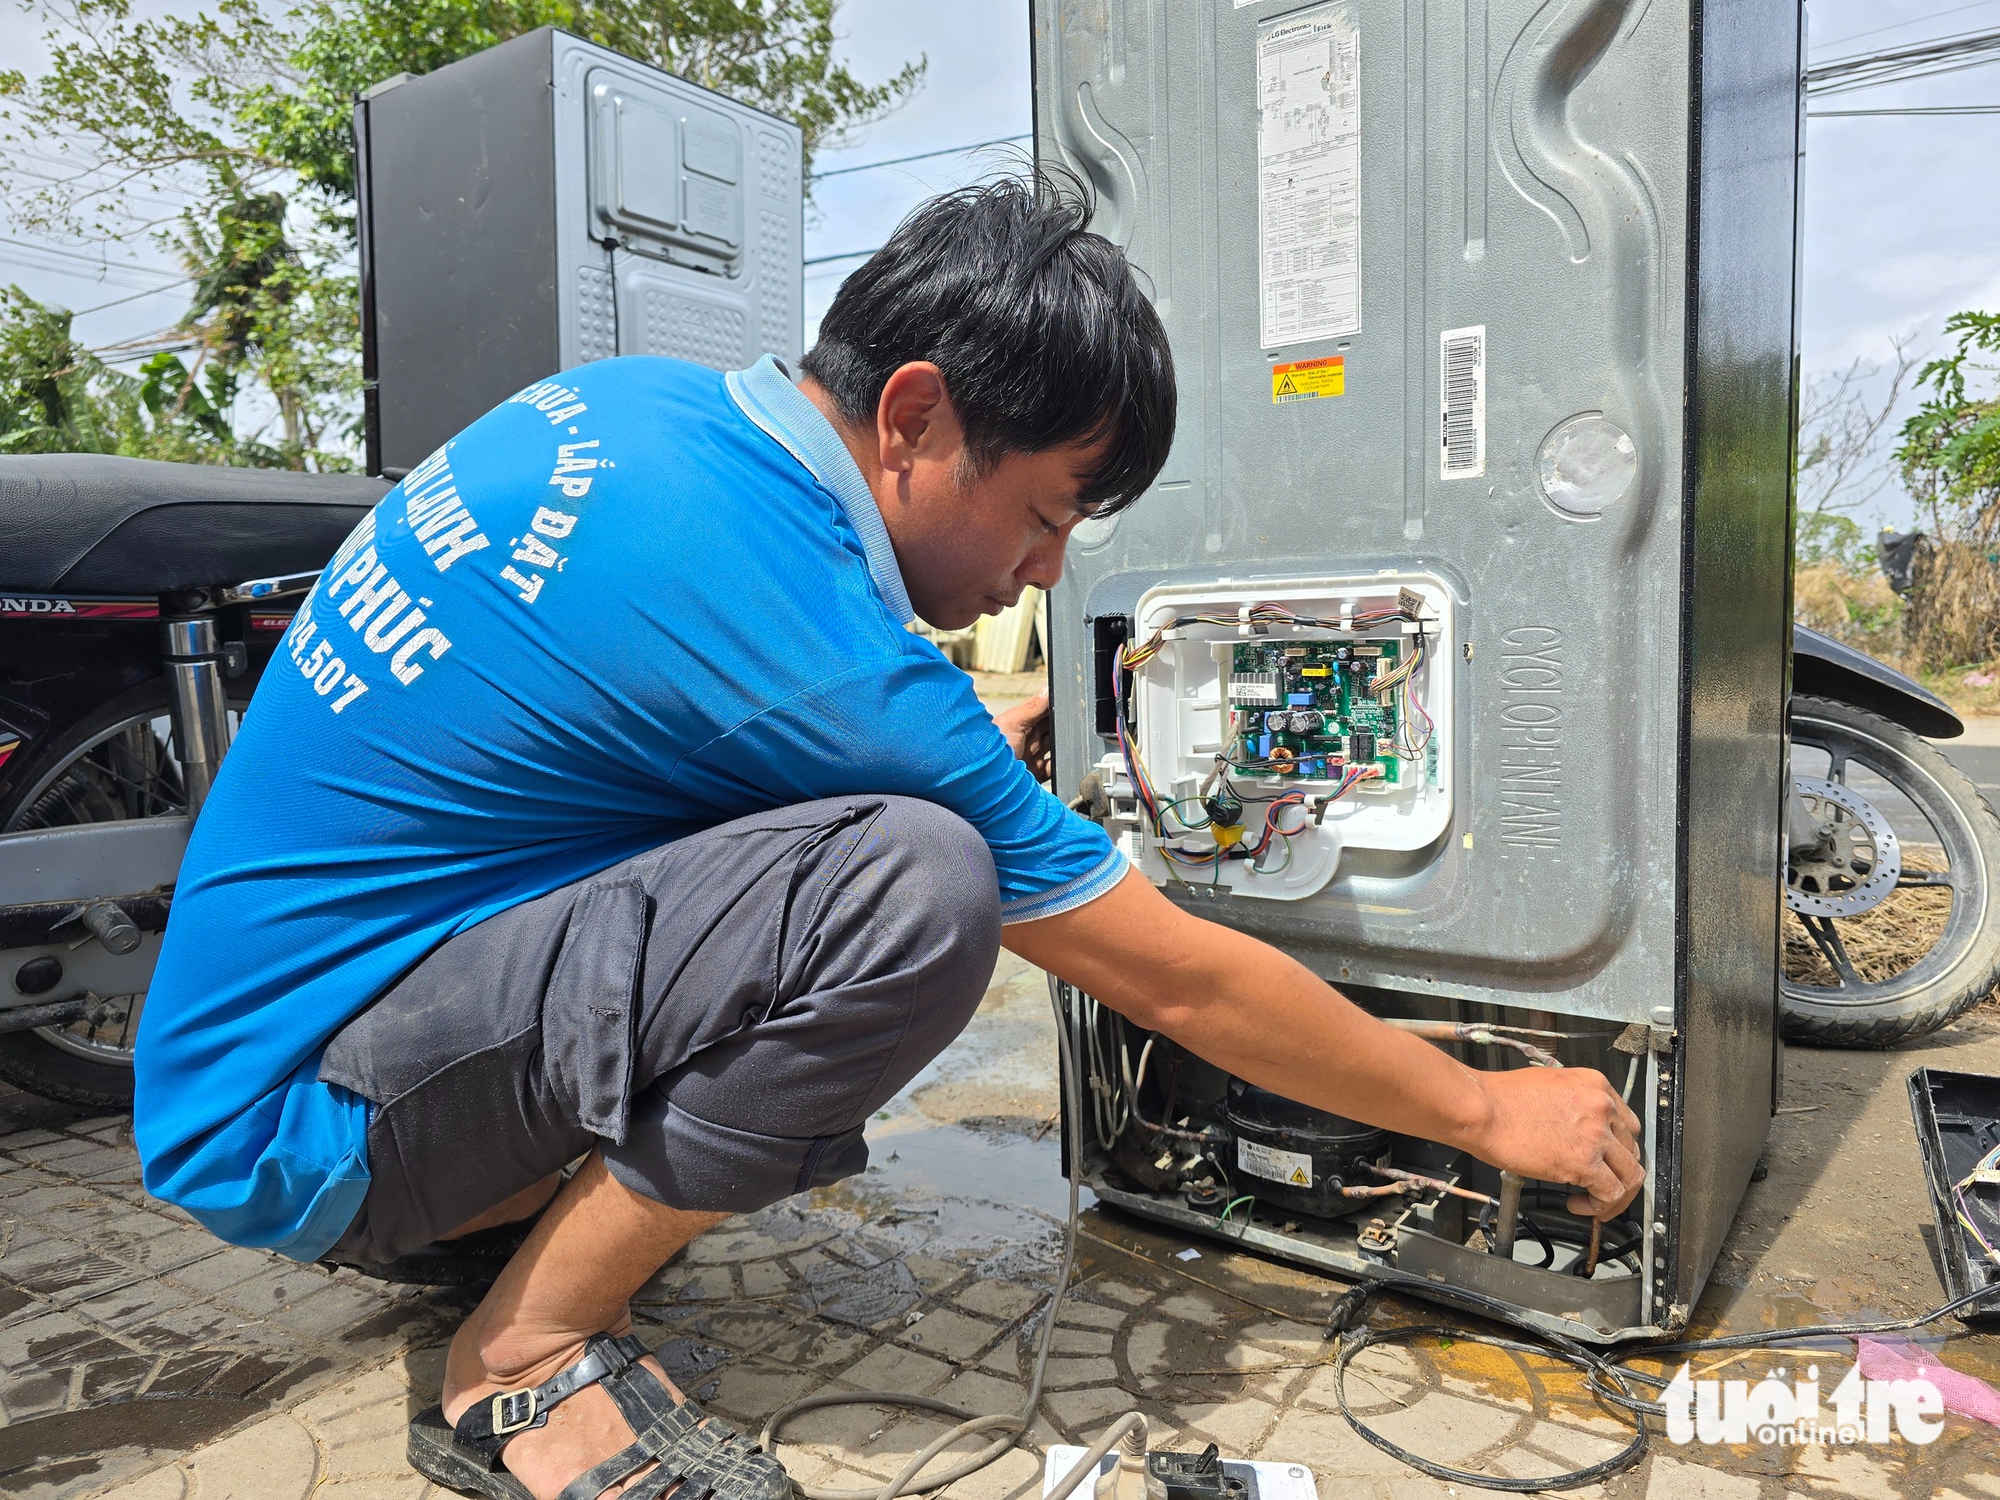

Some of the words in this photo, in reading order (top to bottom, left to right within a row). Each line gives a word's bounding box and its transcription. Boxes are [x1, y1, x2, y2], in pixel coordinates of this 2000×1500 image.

[1271, 30, 1280, 39] LG
[1280, 23, 1311, 36] Electronics
[1295, 360, 1327, 370] WARNING
[0, 598, 76, 613] NDA
[329, 551, 453, 687] PHÚC
[1500, 625, 1564, 863] CYCLOPENTANE
